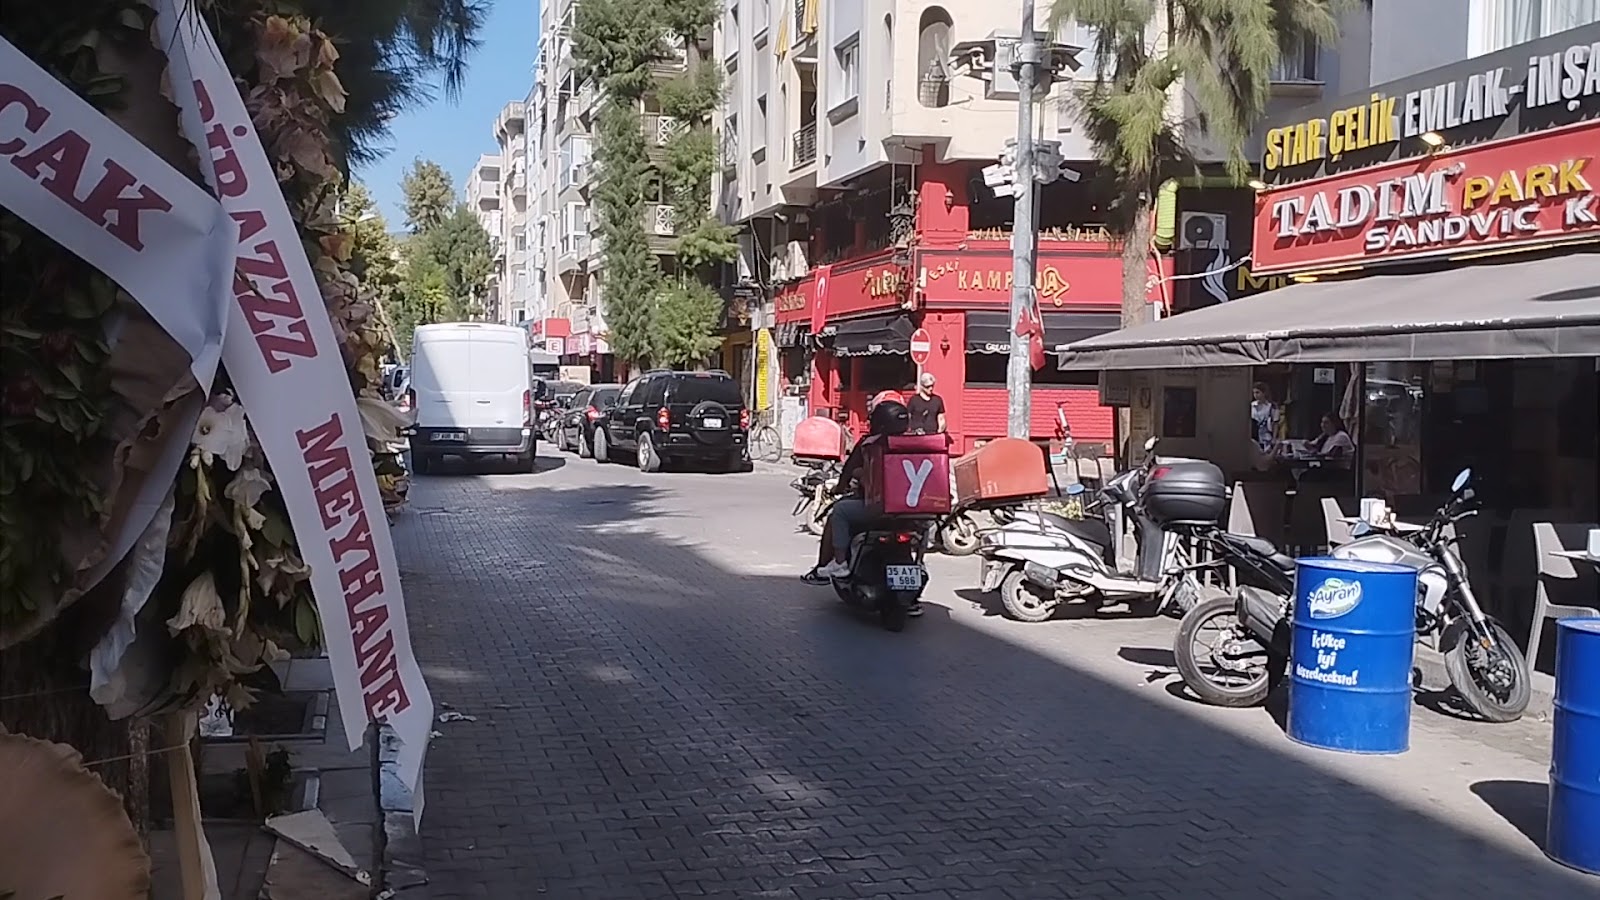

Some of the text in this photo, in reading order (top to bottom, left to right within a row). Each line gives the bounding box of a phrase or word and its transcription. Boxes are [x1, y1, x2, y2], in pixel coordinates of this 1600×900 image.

[1265, 118, 1326, 170] STAR
[1329, 92, 1399, 162] ÇELİK
[0, 83, 172, 252] CAK
[1273, 159, 1592, 238] TADIM PARK
[902, 458, 933, 507] Y
[296, 413, 412, 722] MEYHANE
[887, 567, 920, 576] 35 AYT
[1315, 585, 1359, 604] Ayran
[1317, 649, 1337, 670] iyi
